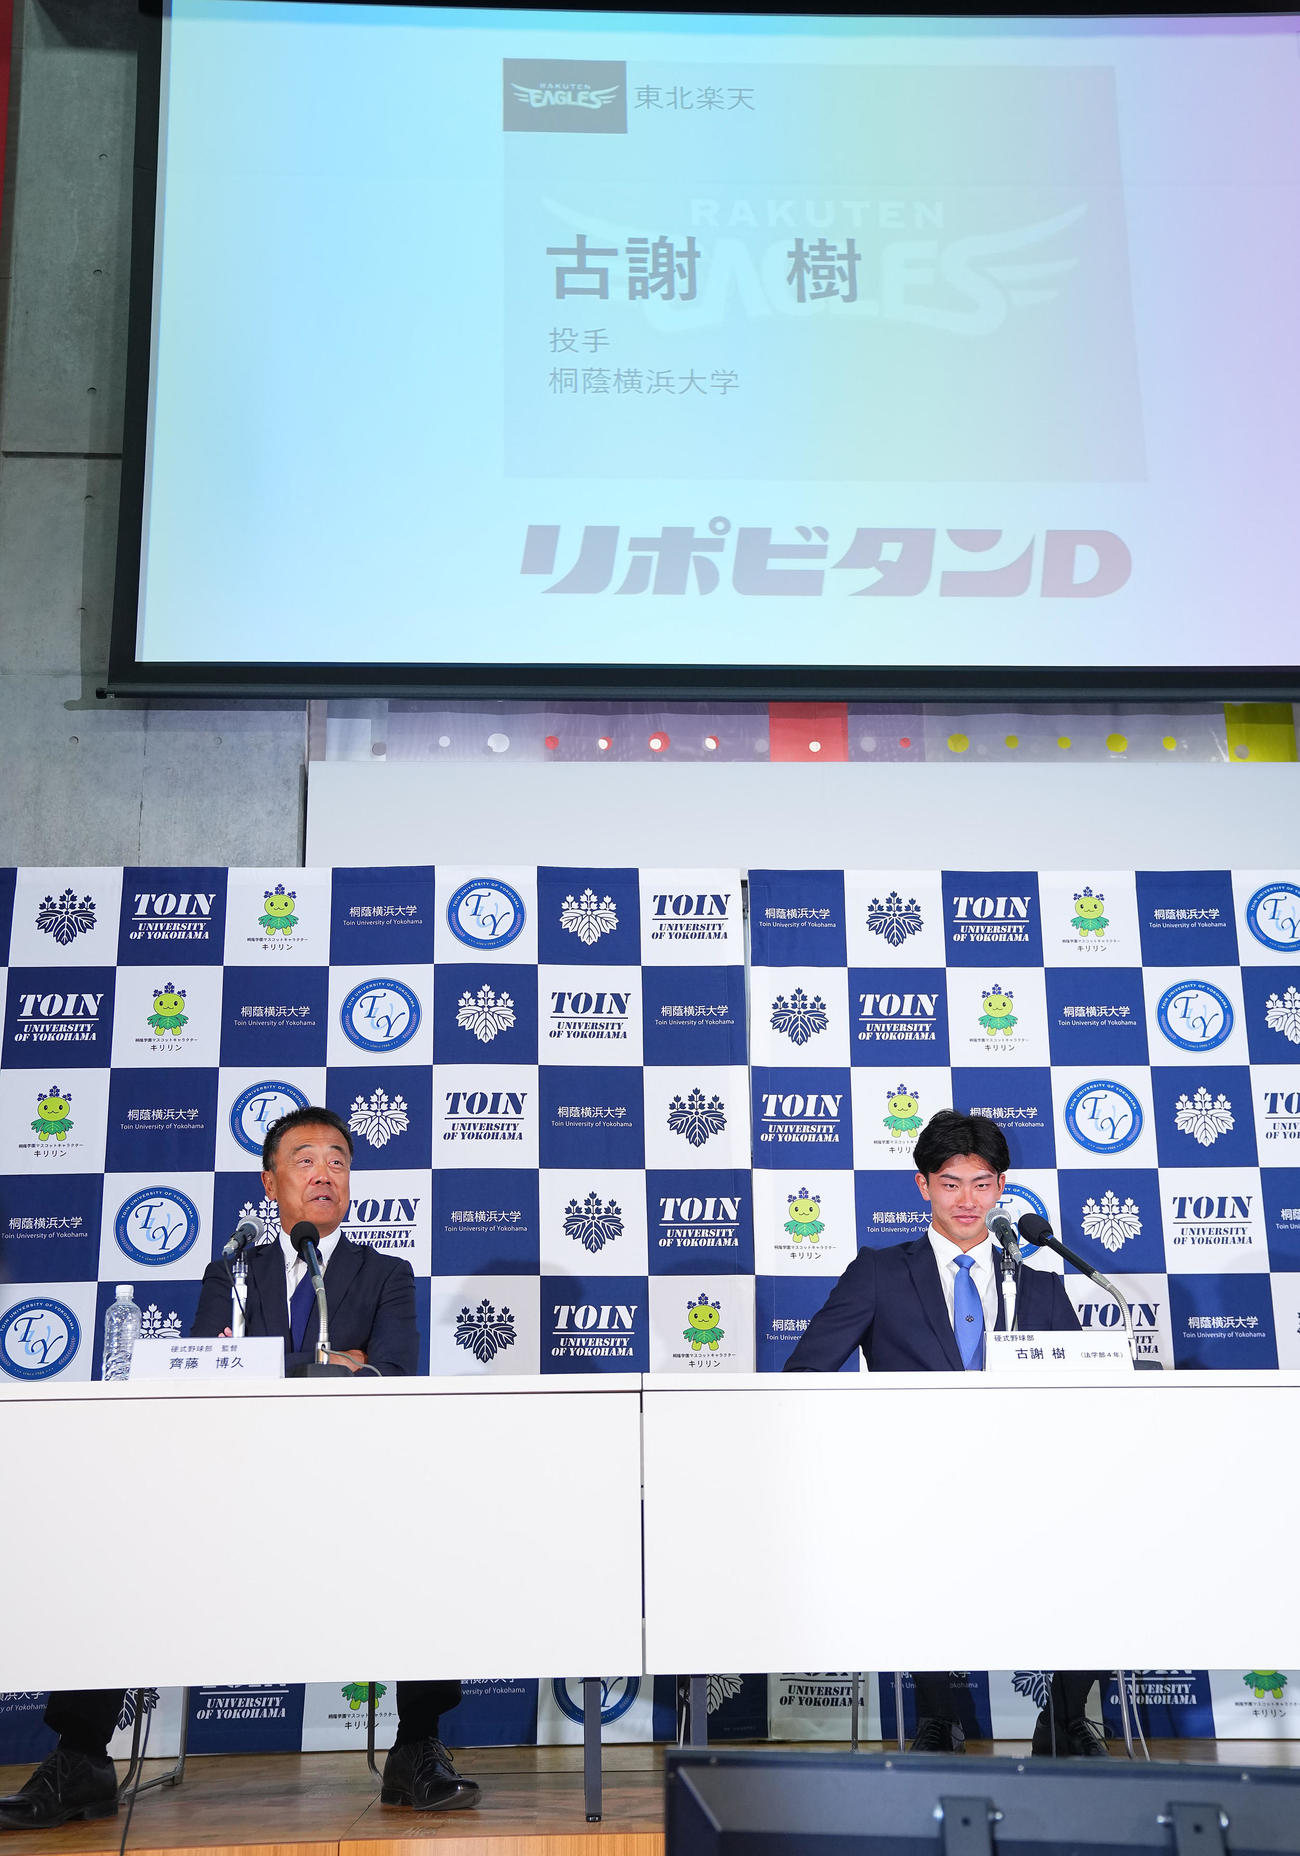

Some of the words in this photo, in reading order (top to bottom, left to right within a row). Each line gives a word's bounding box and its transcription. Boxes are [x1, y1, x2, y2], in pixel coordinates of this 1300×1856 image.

[529, 90, 604, 110] EAGLES
[634, 84, 756, 110] 東北楽天
[690, 200, 946, 230] RAKUTEN
[546, 234, 701, 300] 古謝
[786, 237, 861, 303] 樹
[549, 327, 610, 353] 投手
[549, 367, 740, 395] 桐蔭横浜大学
[520, 516, 1132, 597] リポビタンD
[135, 894, 216, 915] TOIN
[653, 894, 730, 915] TOIN
[954, 897, 1031, 918] TOIN
[349, 905, 417, 918] 桐蔭横浜大学
[764, 907, 831, 920] 桐蔭横浜大学
[1153, 908, 1221, 921] 桐蔭横浜大学
[138, 922, 207, 931] UNIVERSITY
[355, 919, 387, 927] University
[659, 923, 725, 931] UNIVERSITY
[772, 921, 801, 929] University
[1148, 921, 1162, 929] Toin
[130, 930, 144, 939] OF
[148, 930, 208, 939] YOKOHAMA
[960, 925, 1026, 934] UNIVERSITY
[651, 931, 666, 940] OF
[668, 931, 728, 940] YOKOHAMA
[953, 932, 967, 941] OF
[968, 932, 1028, 941] YOKOHAMA
[261, 943, 293, 951] キリリン
[1077, 945, 1107, 953] キリリン
[20, 994, 104, 1016] TOIN
[552, 992, 631, 1014] TOIN
[860, 994, 938, 1016] TOIN
[240, 1005, 311, 1018] 桐蔭横浜大学
[660, 1004, 729, 1017] 桐蔭横浜大学
[1063, 1005, 1131, 1018] 桐蔭横浜大学
[23, 1023, 95, 1033] UNIVERSITY
[247, 1019, 278, 1027] University
[285, 1019, 316, 1027] Yokohama
[557, 1021, 624, 1031] UNIVERSITY
[668, 1019, 697, 1027] University
[865, 1023, 933, 1032] UNIVERSITY
[1071, 1019, 1100, 1027] University
[15, 1031, 30, 1041] OF
[32, 1031, 96, 1041] YOKOHAMA
[548, 1030, 564, 1039] OF
[567, 1029, 626, 1038] YOKOHAMA
[857, 1031, 874, 1041] OF
[875, 1031, 936, 1041] YOKOHAMA
[149, 1044, 183, 1052] キリリン
[984, 1044, 1015, 1052] キリリン
[446, 1092, 527, 1114] TOIN
[762, 1094, 842, 1117] TOIN
[127, 1108, 199, 1121] 桐蔭横浜大学
[557, 1105, 627, 1119] 桐蔭横浜大学
[134, 1123, 165, 1131] University
[451, 1122, 520, 1131] UNIVERSITY
[565, 1120, 595, 1128] University
[768, 1124, 836, 1133] UNIVERSITY
[442, 1131, 459, 1141] OF
[460, 1131, 523, 1141] YOKOHAMA
[760, 1133, 776, 1142] OF
[778, 1132, 839, 1142] YOKOHAMA
[33, 1149, 67, 1158] キリリン
[889, 1146, 914, 1154] キリリ
[660, 1198, 741, 1220] TOIN
[1173, 1196, 1252, 1218] TOIN
[450, 1210, 522, 1223] 桐蔭横浜大学
[872, 1211, 932, 1224] 桐蔭横浜大
[8, 1216, 83, 1230] 桐蔭横浜大学
[458, 1225, 489, 1233] University
[666, 1228, 735, 1238] UNIVERSITY
[1181, 1227, 1246, 1236] UNIVERSITY
[16, 1232, 48, 1240] University
[55, 1231, 89, 1239] Yokohama
[1173, 1236, 1188, 1245] OF
[1190, 1236, 1253, 1245] YOKOHAMA
[659, 1237, 673, 1246] OF
[677, 1237, 738, 1246] YOKOHAMA
[789, 1251, 822, 1260] キリリン
[554, 1305, 638, 1329] TOIN
[1078, 1304, 1160, 1327] TON
[1187, 1315, 1259, 1329] 桐蔭横浜大学
[766, 1333, 779, 1341] Toin
[1196, 1331, 1227, 1339] University
[559, 1337, 630, 1347] UNIVERSITY
[552, 1346, 566, 1356] OF
[570, 1346, 633, 1356] YOKOHAMA
[1015, 1348, 1044, 1360] 古謝
[1052, 1348, 1066, 1360] 樹
[215, 1357, 244, 1369] 博久
[688, 1359, 721, 1369] キリリン
[788, 1684, 862, 1696] UNIVERSIT
[1126, 1683, 1192, 1694] NIVERSITY
[206, 1697, 283, 1709] UNIVERSITY
[779, 1696, 795, 1706] OF
[197, 1709, 213, 1720] OF
[216, 1708, 286, 1719] YOKOHAMA
